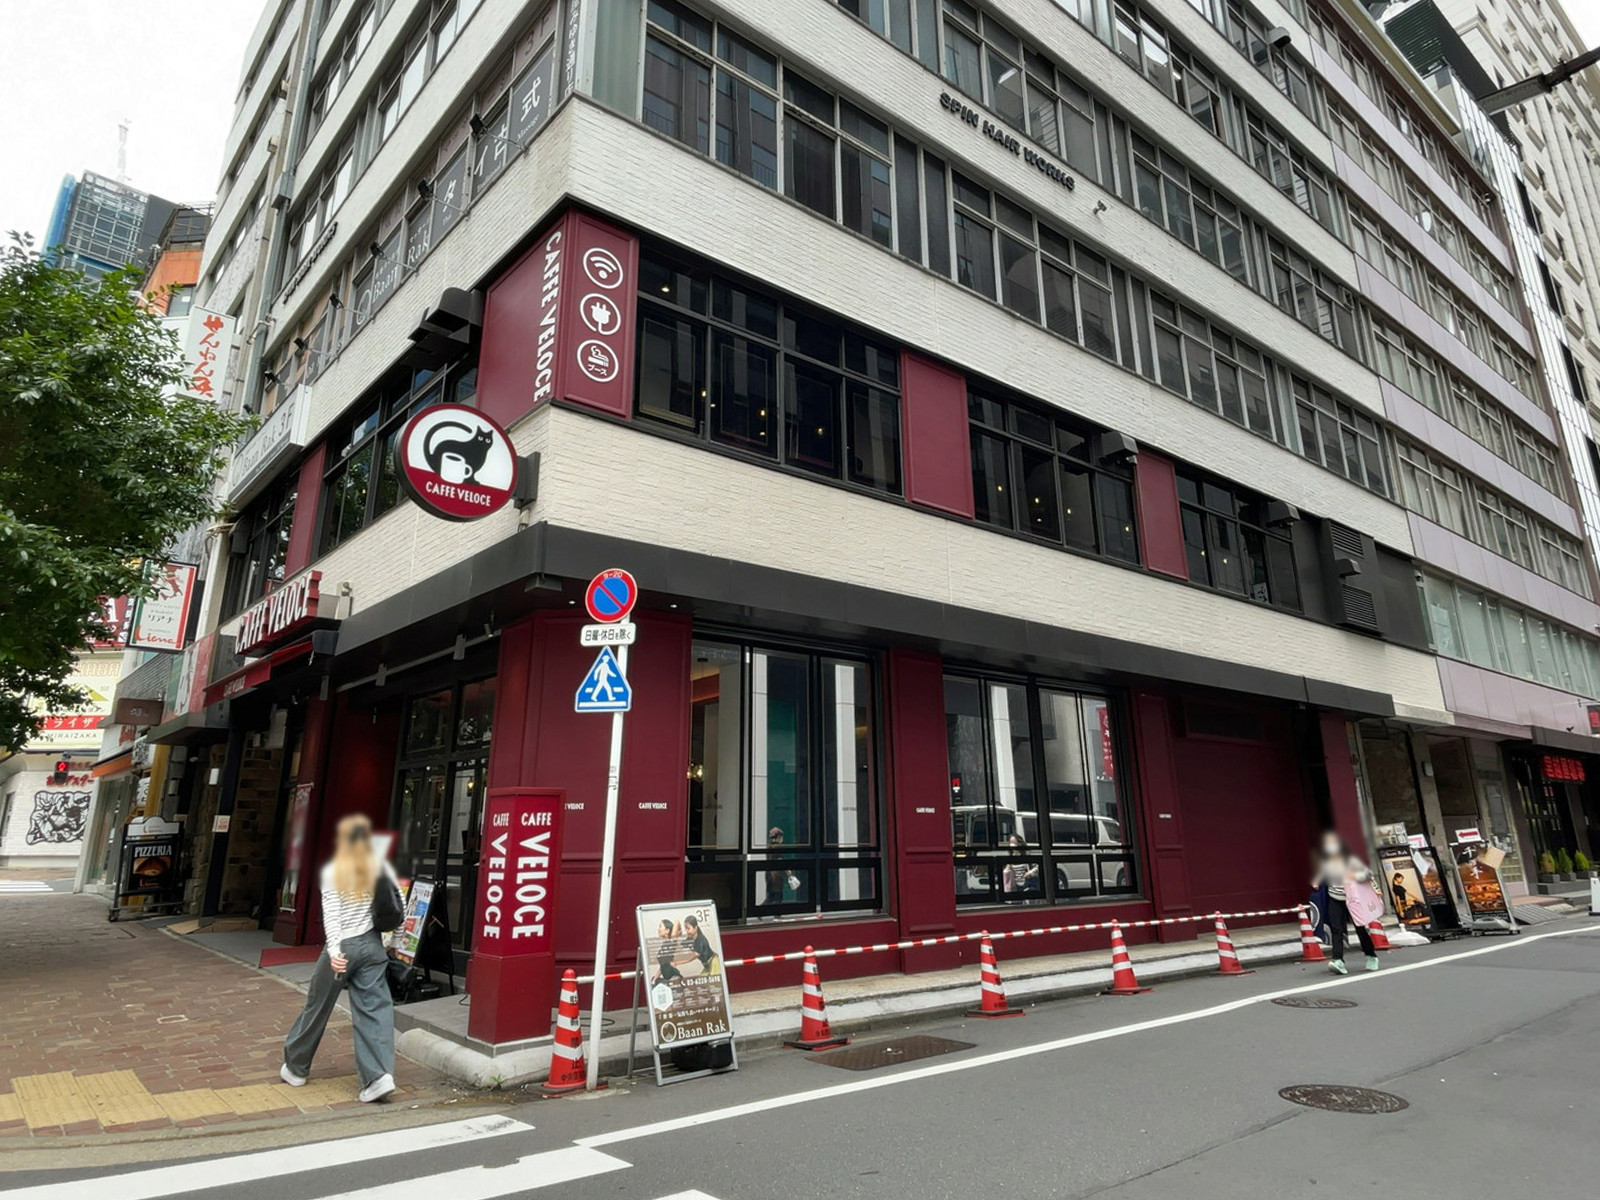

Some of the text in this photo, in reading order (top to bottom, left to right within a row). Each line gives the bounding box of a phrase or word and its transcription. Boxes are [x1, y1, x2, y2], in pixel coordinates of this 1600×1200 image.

[940, 92, 1075, 191] SPIN HAIR WORKS
[533, 303, 557, 402] VELOCE
[587, 363, 608, 376] ブース
[425, 481, 491, 507] CAFFE VELOCE
[603, 571, 623, 579] 9-20
[235, 571, 318, 654] CAFFE VELOCE
[521, 812, 552, 826] CAFFE
[134, 845, 172, 858] PIZZERIA
[483, 832, 509, 939] VELOCE
[512, 831, 551, 939] VELOCE
[696, 909, 710, 923] 3F
[677, 1026, 703, 1040] Baan
[707, 1020, 727, 1035] Rak
